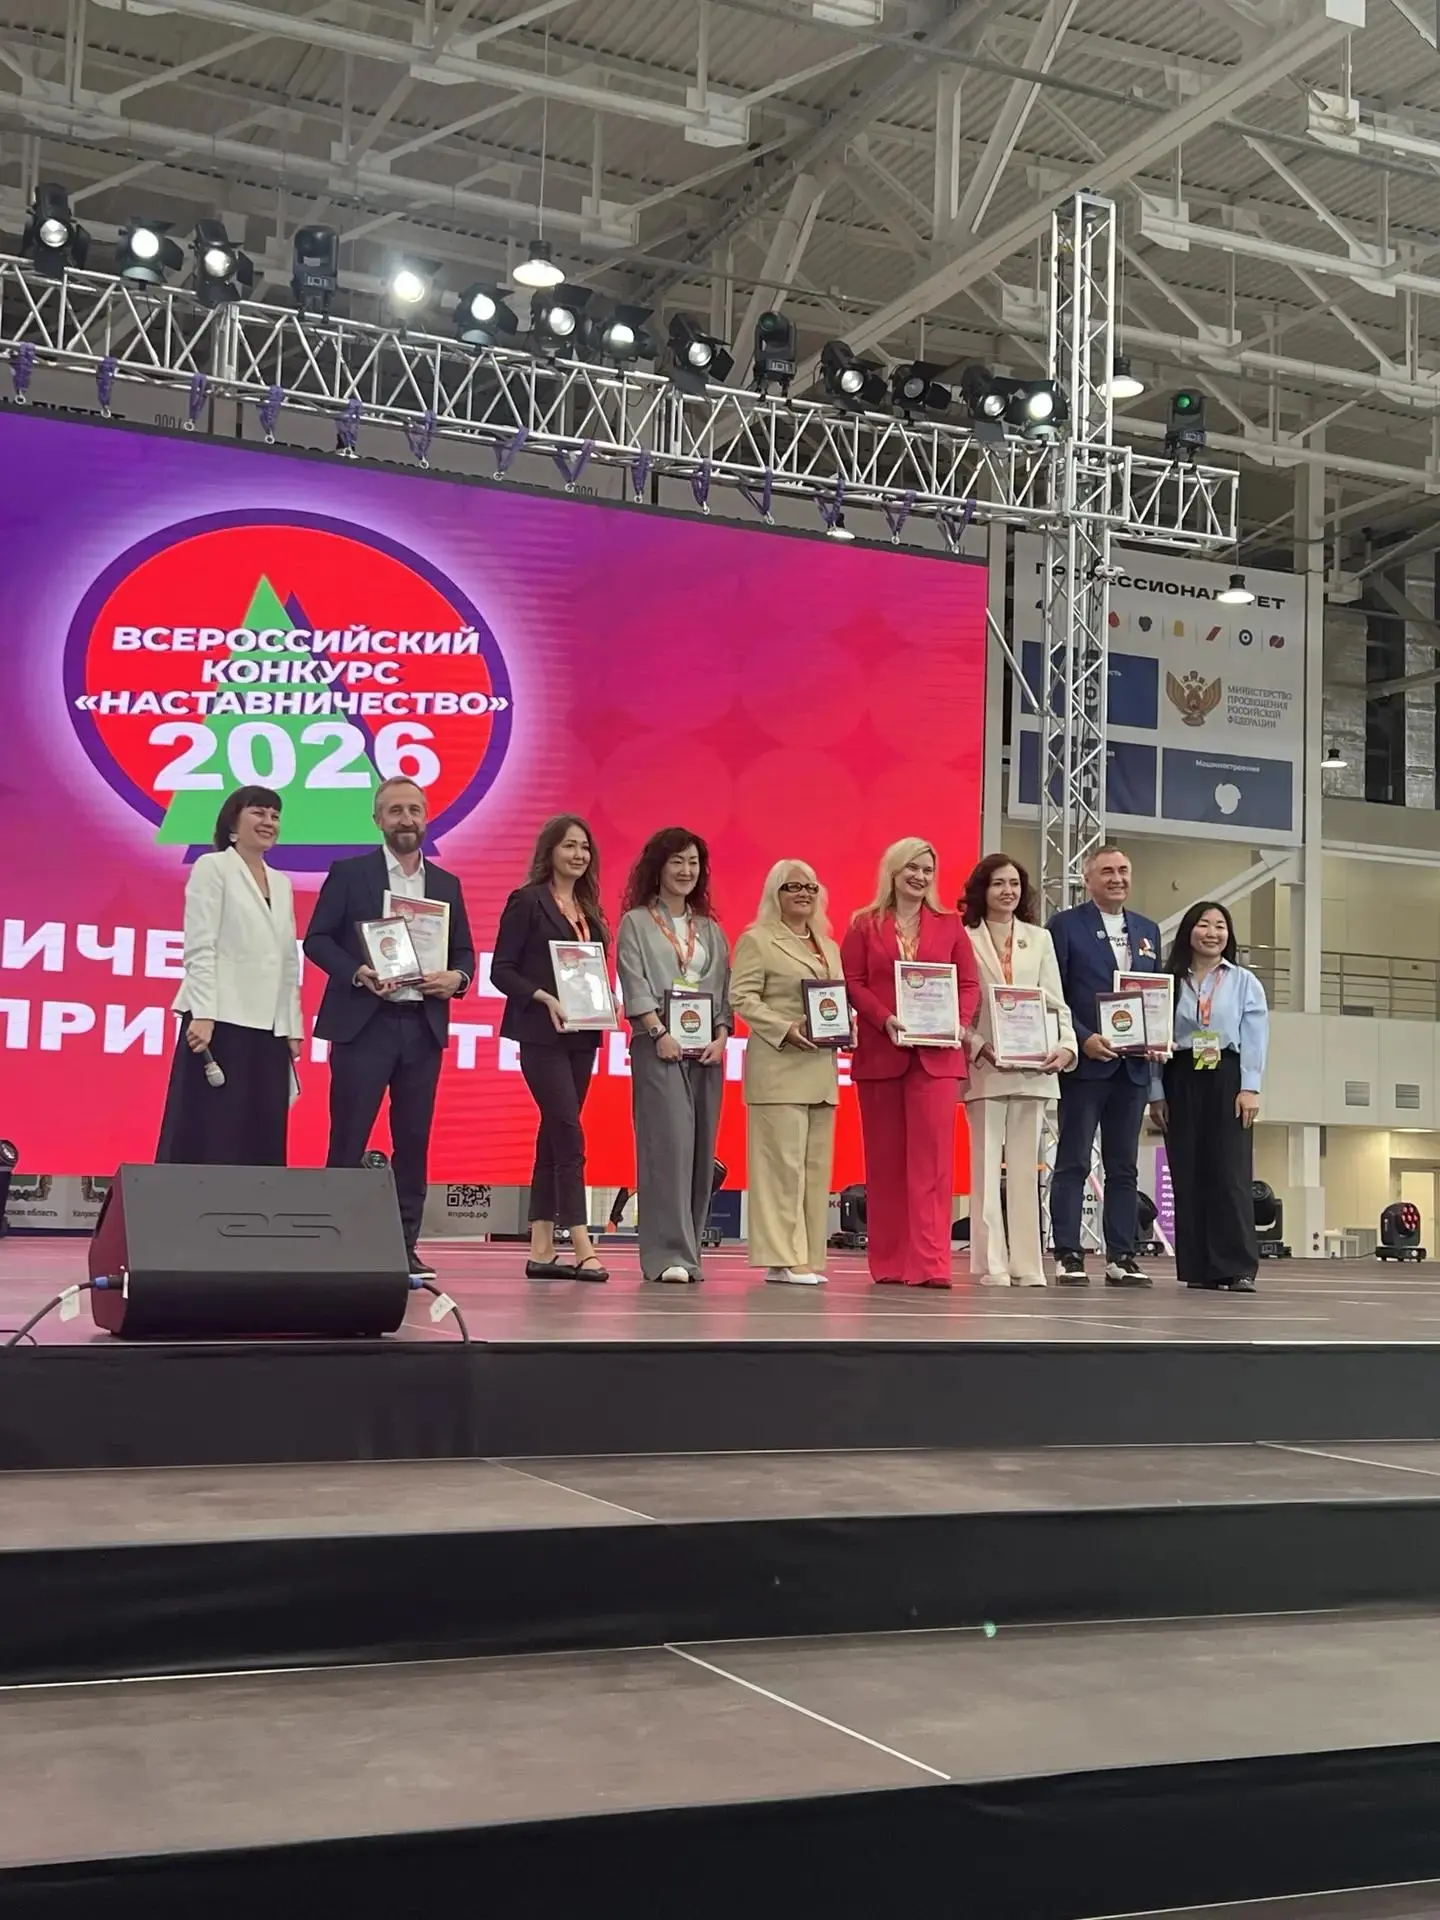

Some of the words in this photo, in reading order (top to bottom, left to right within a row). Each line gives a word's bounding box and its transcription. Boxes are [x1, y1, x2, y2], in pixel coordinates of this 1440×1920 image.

[112, 626, 480, 655] ВСЕРОССИЙСКИЙ
[201, 659, 400, 685] КОНКУРС
[1227, 685, 1293, 700] МИНИСТЕРСТВО
[1227, 695, 1289, 710] ПРОСВЕЩЕНИЯ
[74, 690, 509, 716] «НАСТАВНИЧЕСТВО»
[1227, 704, 1282, 719] РОССИЙСКОЙ
[1226, 715, 1277, 728] ФЕДЕРАЦИИ
[148, 721, 441, 791] 2026
